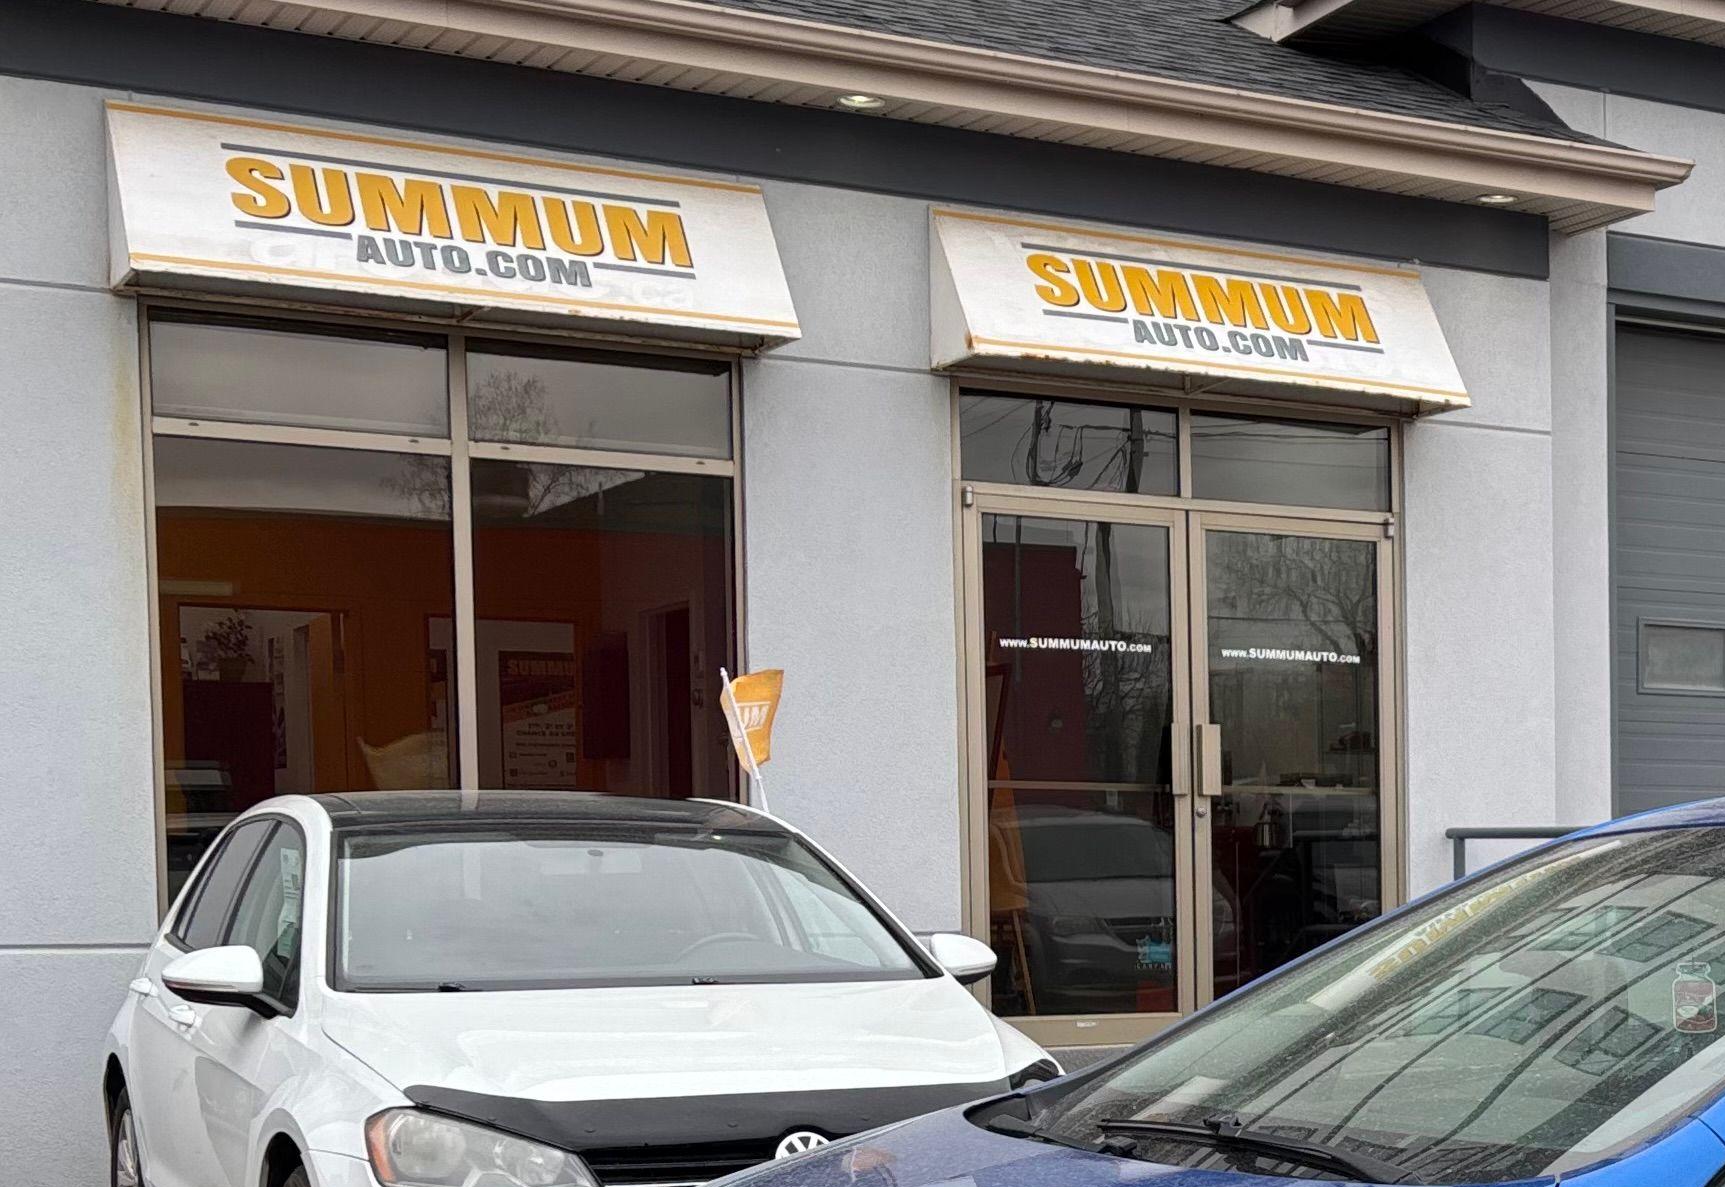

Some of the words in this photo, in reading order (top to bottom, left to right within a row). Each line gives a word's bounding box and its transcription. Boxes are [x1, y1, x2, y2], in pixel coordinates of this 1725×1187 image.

[225, 156, 694, 268] SUMMUM
[356, 235, 593, 288] AUTO.COM
[1026, 253, 1382, 344] SUMMUM
[1133, 319, 1310, 362] AUTO.COM
